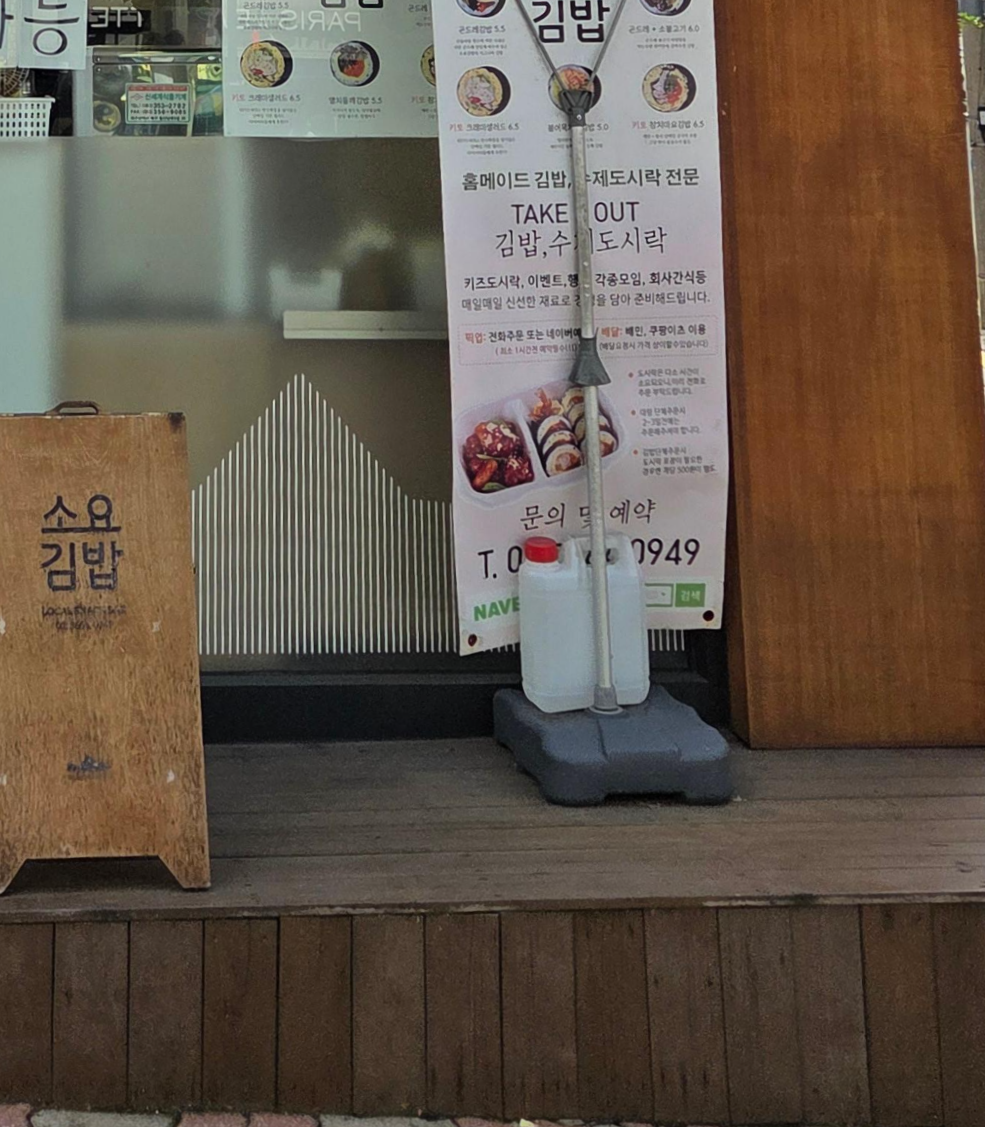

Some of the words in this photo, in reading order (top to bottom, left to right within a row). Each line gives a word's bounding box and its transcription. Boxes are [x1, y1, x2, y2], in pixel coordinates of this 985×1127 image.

[458, 25, 493, 34] 곤드레김밥
[494, 25, 506, 33] 5.5
[532, 0, 610, 44] 김밥
[628, 25, 650, 34] 곤드레
[659, 24, 686, 34] 소불고기
[688, 24, 700, 33] 6.0
[508, 122, 520, 131] 6.5
[597, 123, 610, 131] 5.0
[693, 119, 705, 128] 6.5
[462, 172, 531, 192] 홈메이드
[533, 170, 572, 189] 김밥,
[665, 167, 700, 186] 전문
[511, 203, 569, 225] TAKE
[593, 201, 640, 223] OUT
[464, 274, 525, 291] 키즈도시락,
[595, 272, 646, 288] 각종모임,
[649, 270, 707, 286] 회사간식등
[461, 296, 502, 312] 매일매일
[505, 295, 536, 311] 신선한
[539, 294, 571, 308] 재료로
[610, 292, 631, 307] 담아
[634, 291, 711, 306] 준비해드립니다.
[489, 330, 524, 343] 전화주문
[526, 329, 544, 341] 또는
[601, 327, 623, 338] 배달:
[625, 325, 647, 338] 배민,
[649, 324, 686, 337] 쿠팡이츠
[688, 323, 707, 336] 이용
[41, 494, 121, 534] 소요
[520, 502, 565, 531] 문의
[609, 498, 656, 525] 예약
[40, 540, 123, 591] 김밥
[477, 549, 498, 579] T.
[630, 537, 701, 566] 0949
[680, 590, 702, 602] 검색
[473, 596, 520, 621] NAVE
